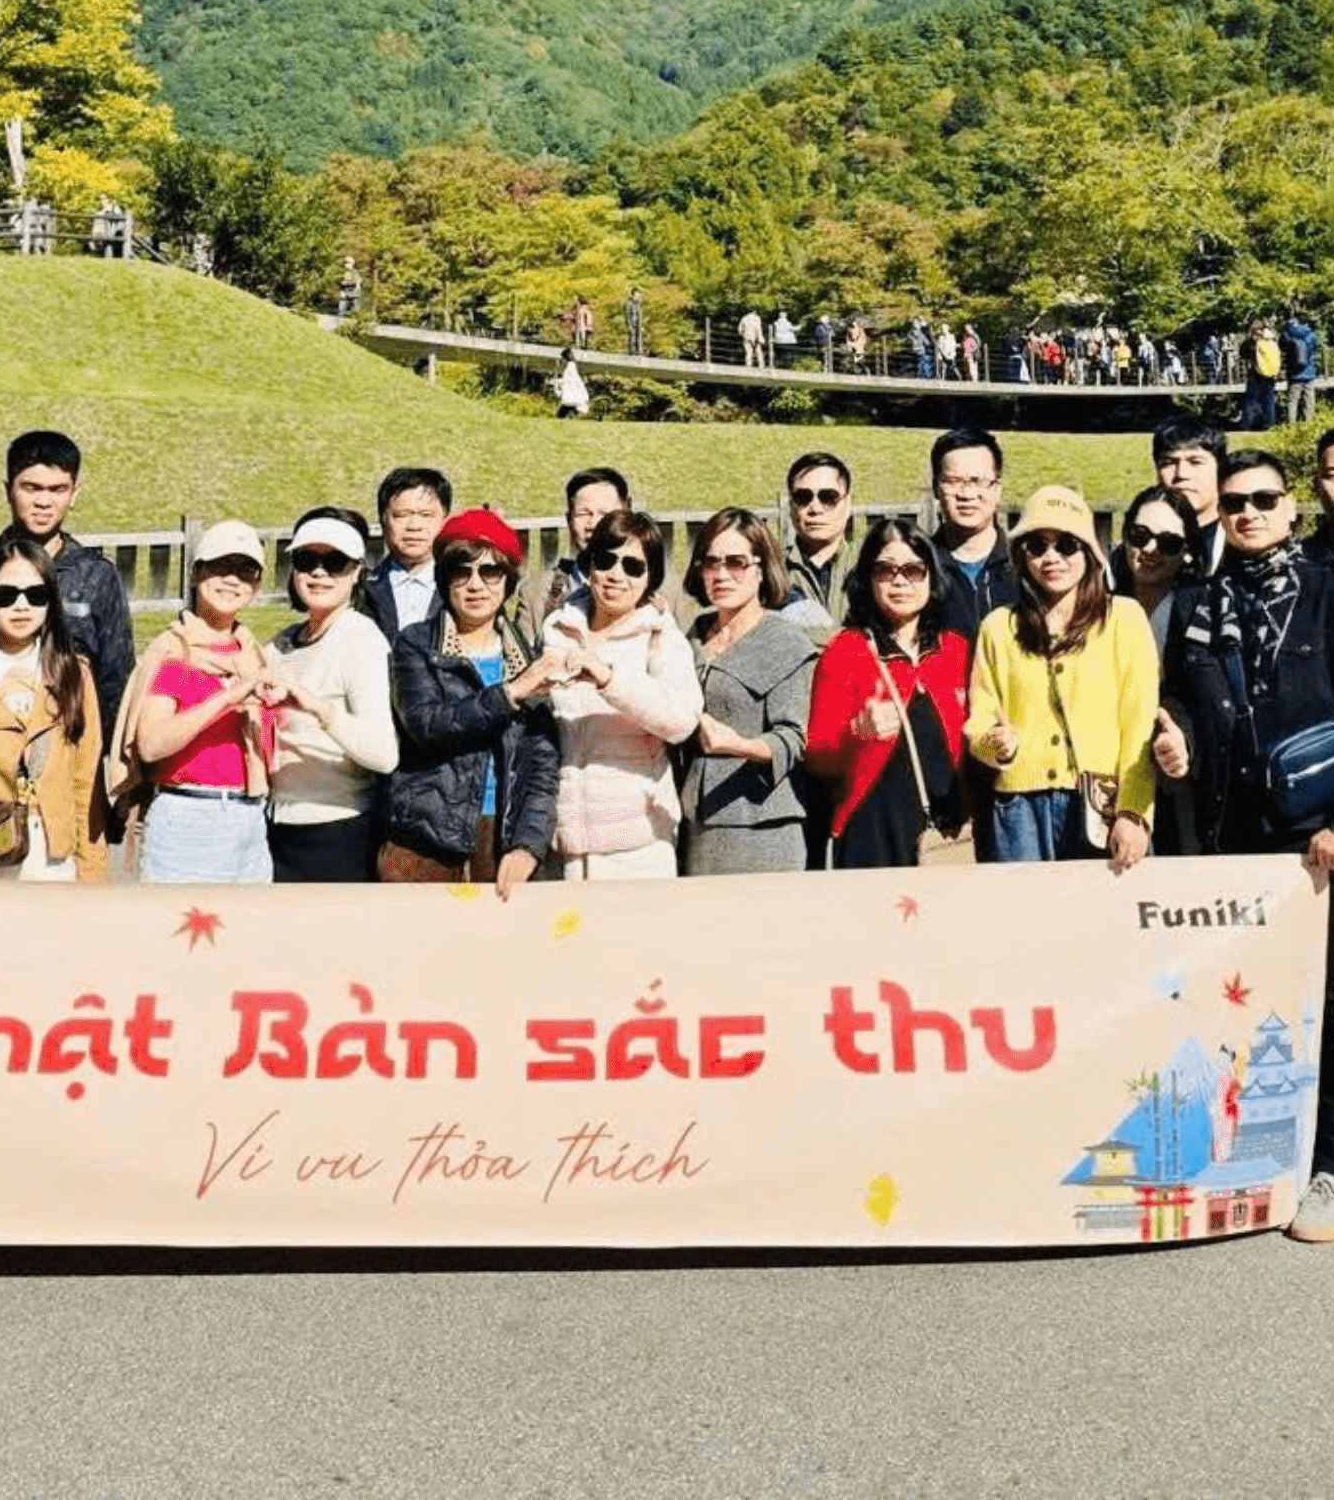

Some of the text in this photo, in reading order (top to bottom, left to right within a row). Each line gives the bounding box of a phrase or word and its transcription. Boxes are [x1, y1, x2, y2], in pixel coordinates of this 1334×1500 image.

[1136, 899, 1267, 928] Funiki
[525, 978, 766, 1083] sắc
[823, 979, 1057, 1075] thu
[196, 1110, 711, 1204] Vi vu thỏa thích
